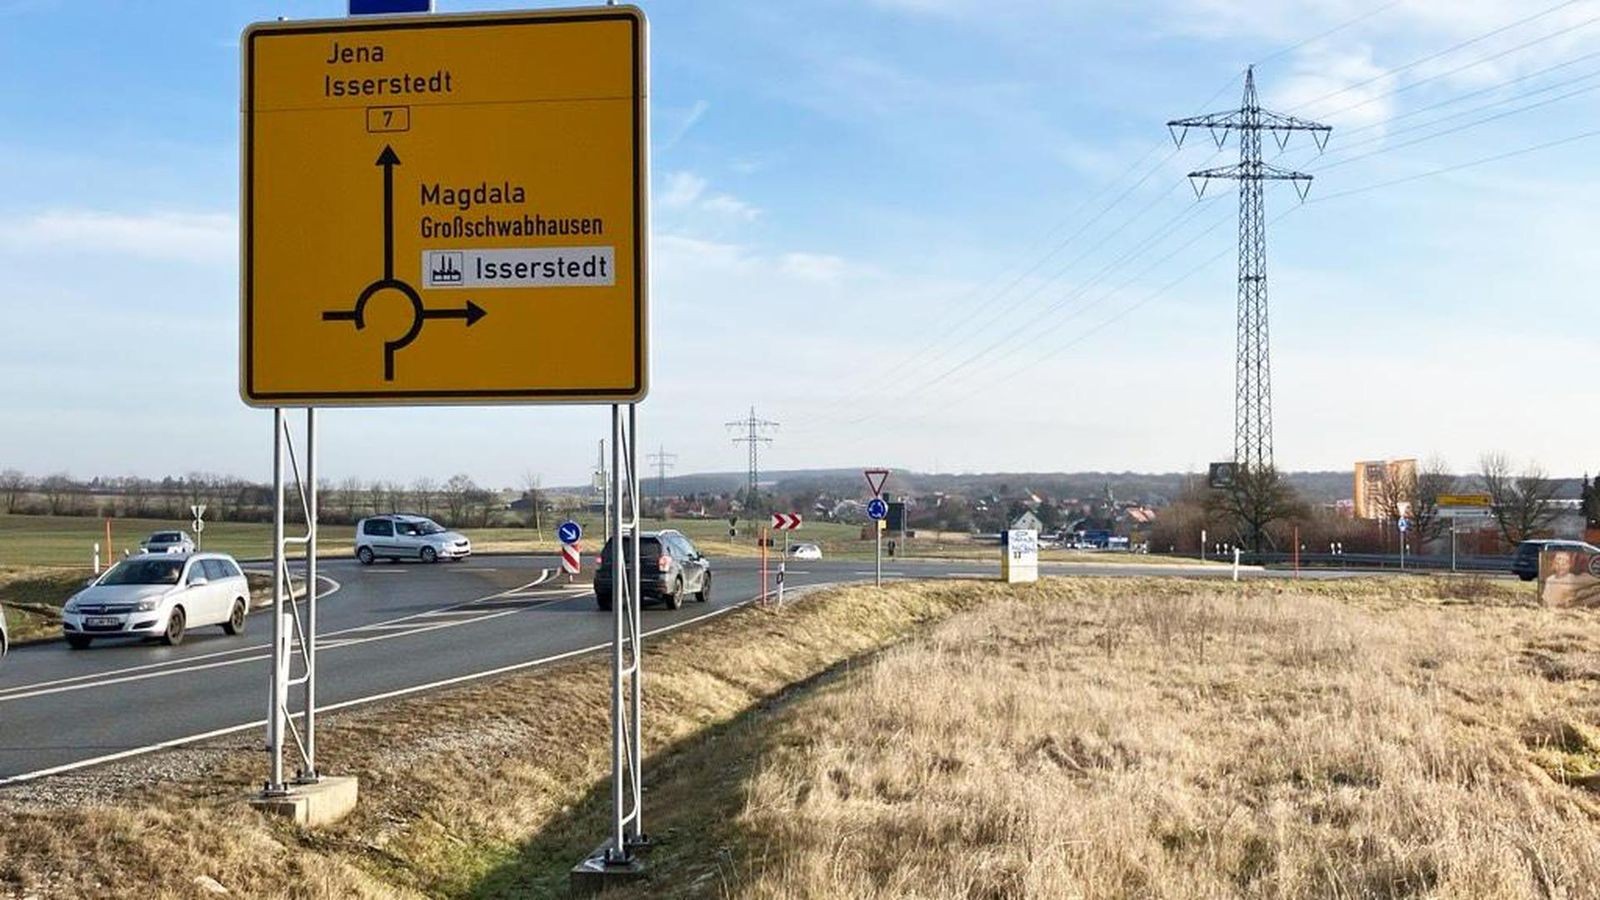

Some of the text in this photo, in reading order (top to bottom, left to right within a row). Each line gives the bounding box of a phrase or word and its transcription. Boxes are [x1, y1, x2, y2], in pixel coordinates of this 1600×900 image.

[326, 42, 384, 64] Jena
[325, 70, 452, 97] Isserstedt
[383, 111, 393, 128] 7
[421, 182, 525, 209] Magdala
[421, 215, 603, 238] Großschwabhausen
[476, 256, 607, 279] Isserstedt
